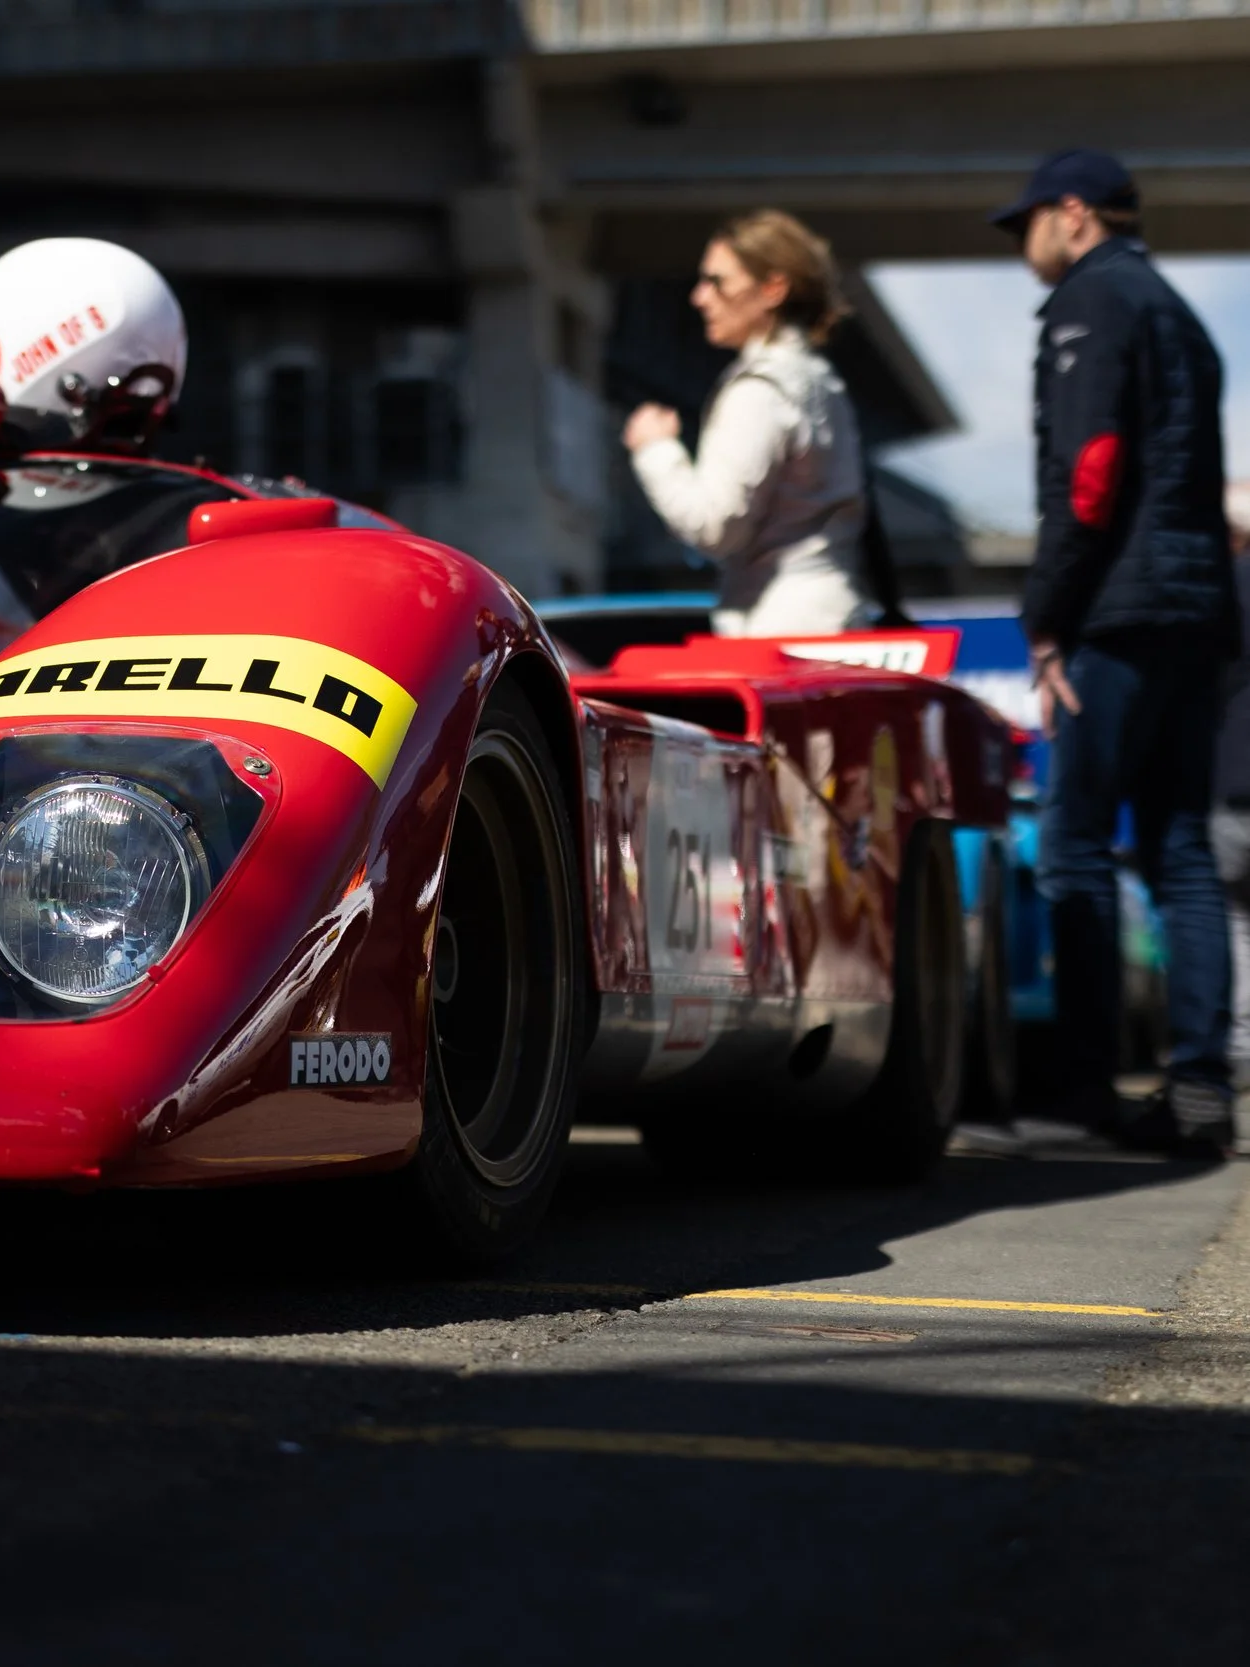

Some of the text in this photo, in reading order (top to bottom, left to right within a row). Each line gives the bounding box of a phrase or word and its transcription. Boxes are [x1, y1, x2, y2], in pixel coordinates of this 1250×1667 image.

[13, 334, 58, 383] JOHN
[665, 828, 712, 953] 251
[290, 1040, 390, 1084] FERODO
